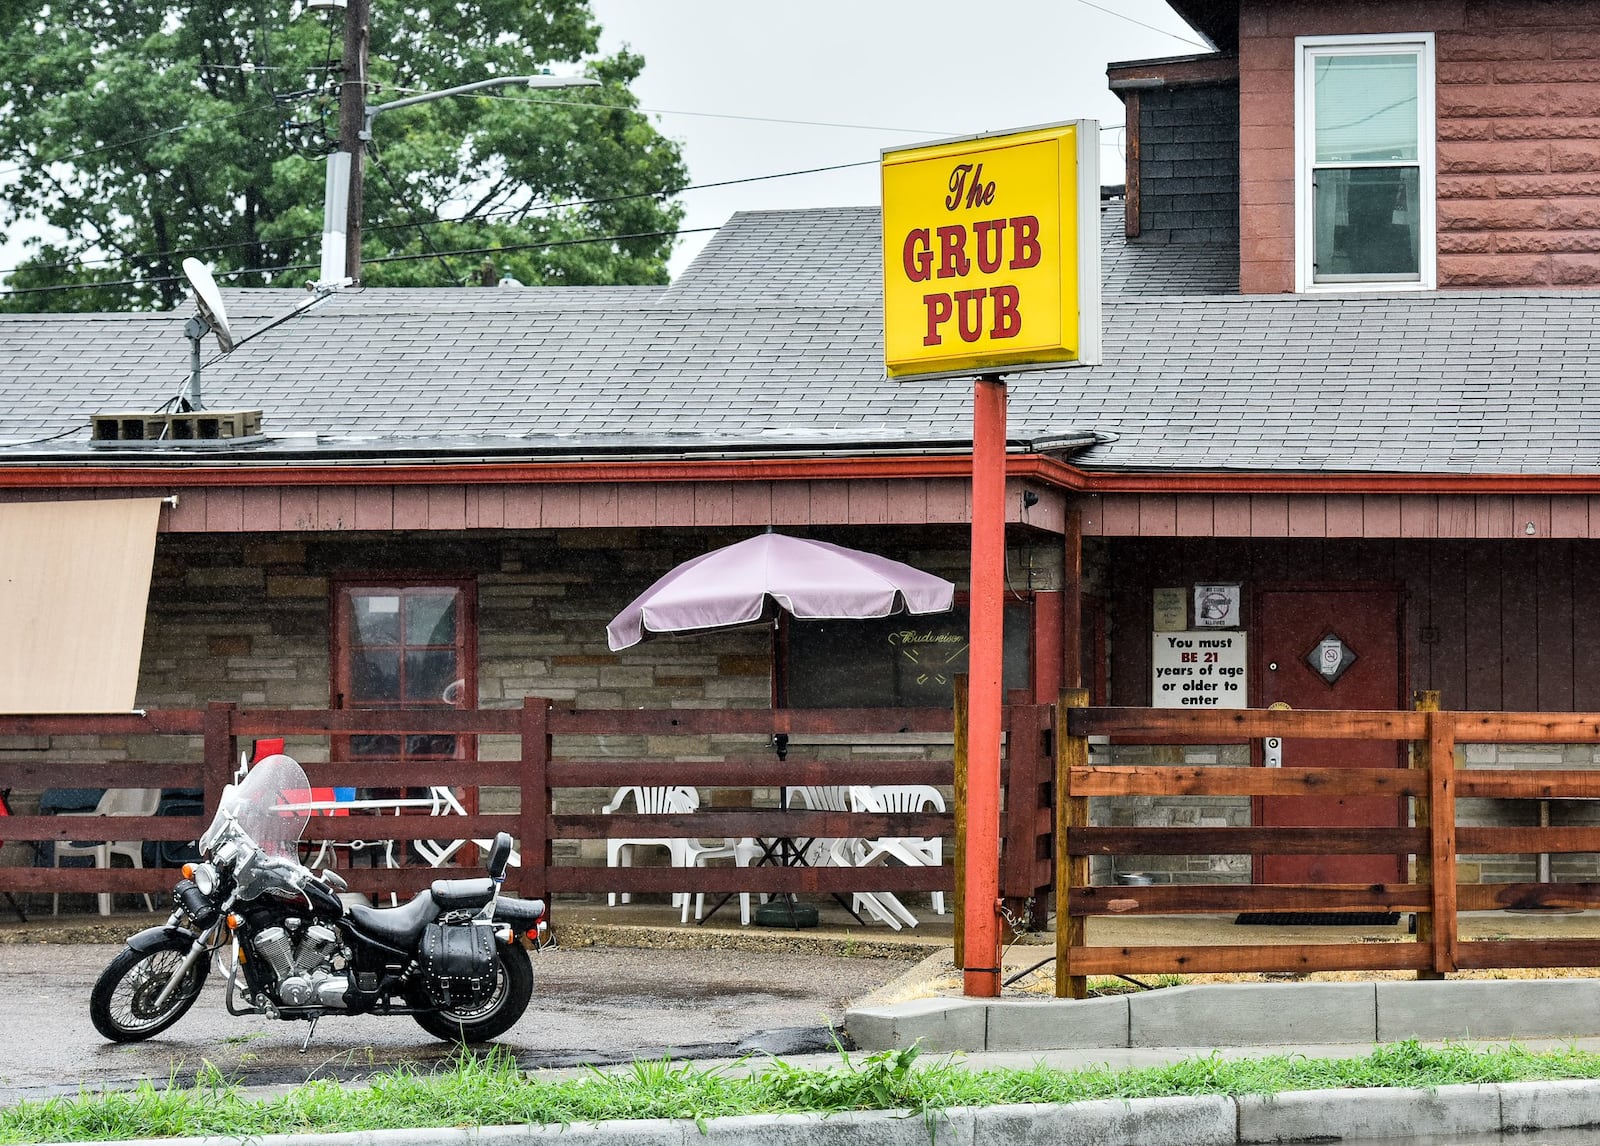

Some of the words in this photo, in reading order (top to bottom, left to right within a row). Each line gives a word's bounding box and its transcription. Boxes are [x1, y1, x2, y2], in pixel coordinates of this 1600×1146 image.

[945, 163, 996, 211] The
[902, 215, 1042, 282] GRUB
[923, 284, 1022, 346] PUB
[1168, 637, 1193, 648] You
[1199, 638, 1232, 648] must
[1181, 652, 1198, 663] BE
[1204, 652, 1218, 663] 21
[1156, 667, 1193, 678] years
[1199, 664, 1213, 676] of
[1218, 667, 1244, 677] age
[1162, 683, 1177, 691] or
[1182, 680, 1218, 691] older
[1224, 681, 1238, 691] to
[1181, 695, 1219, 705] enter
